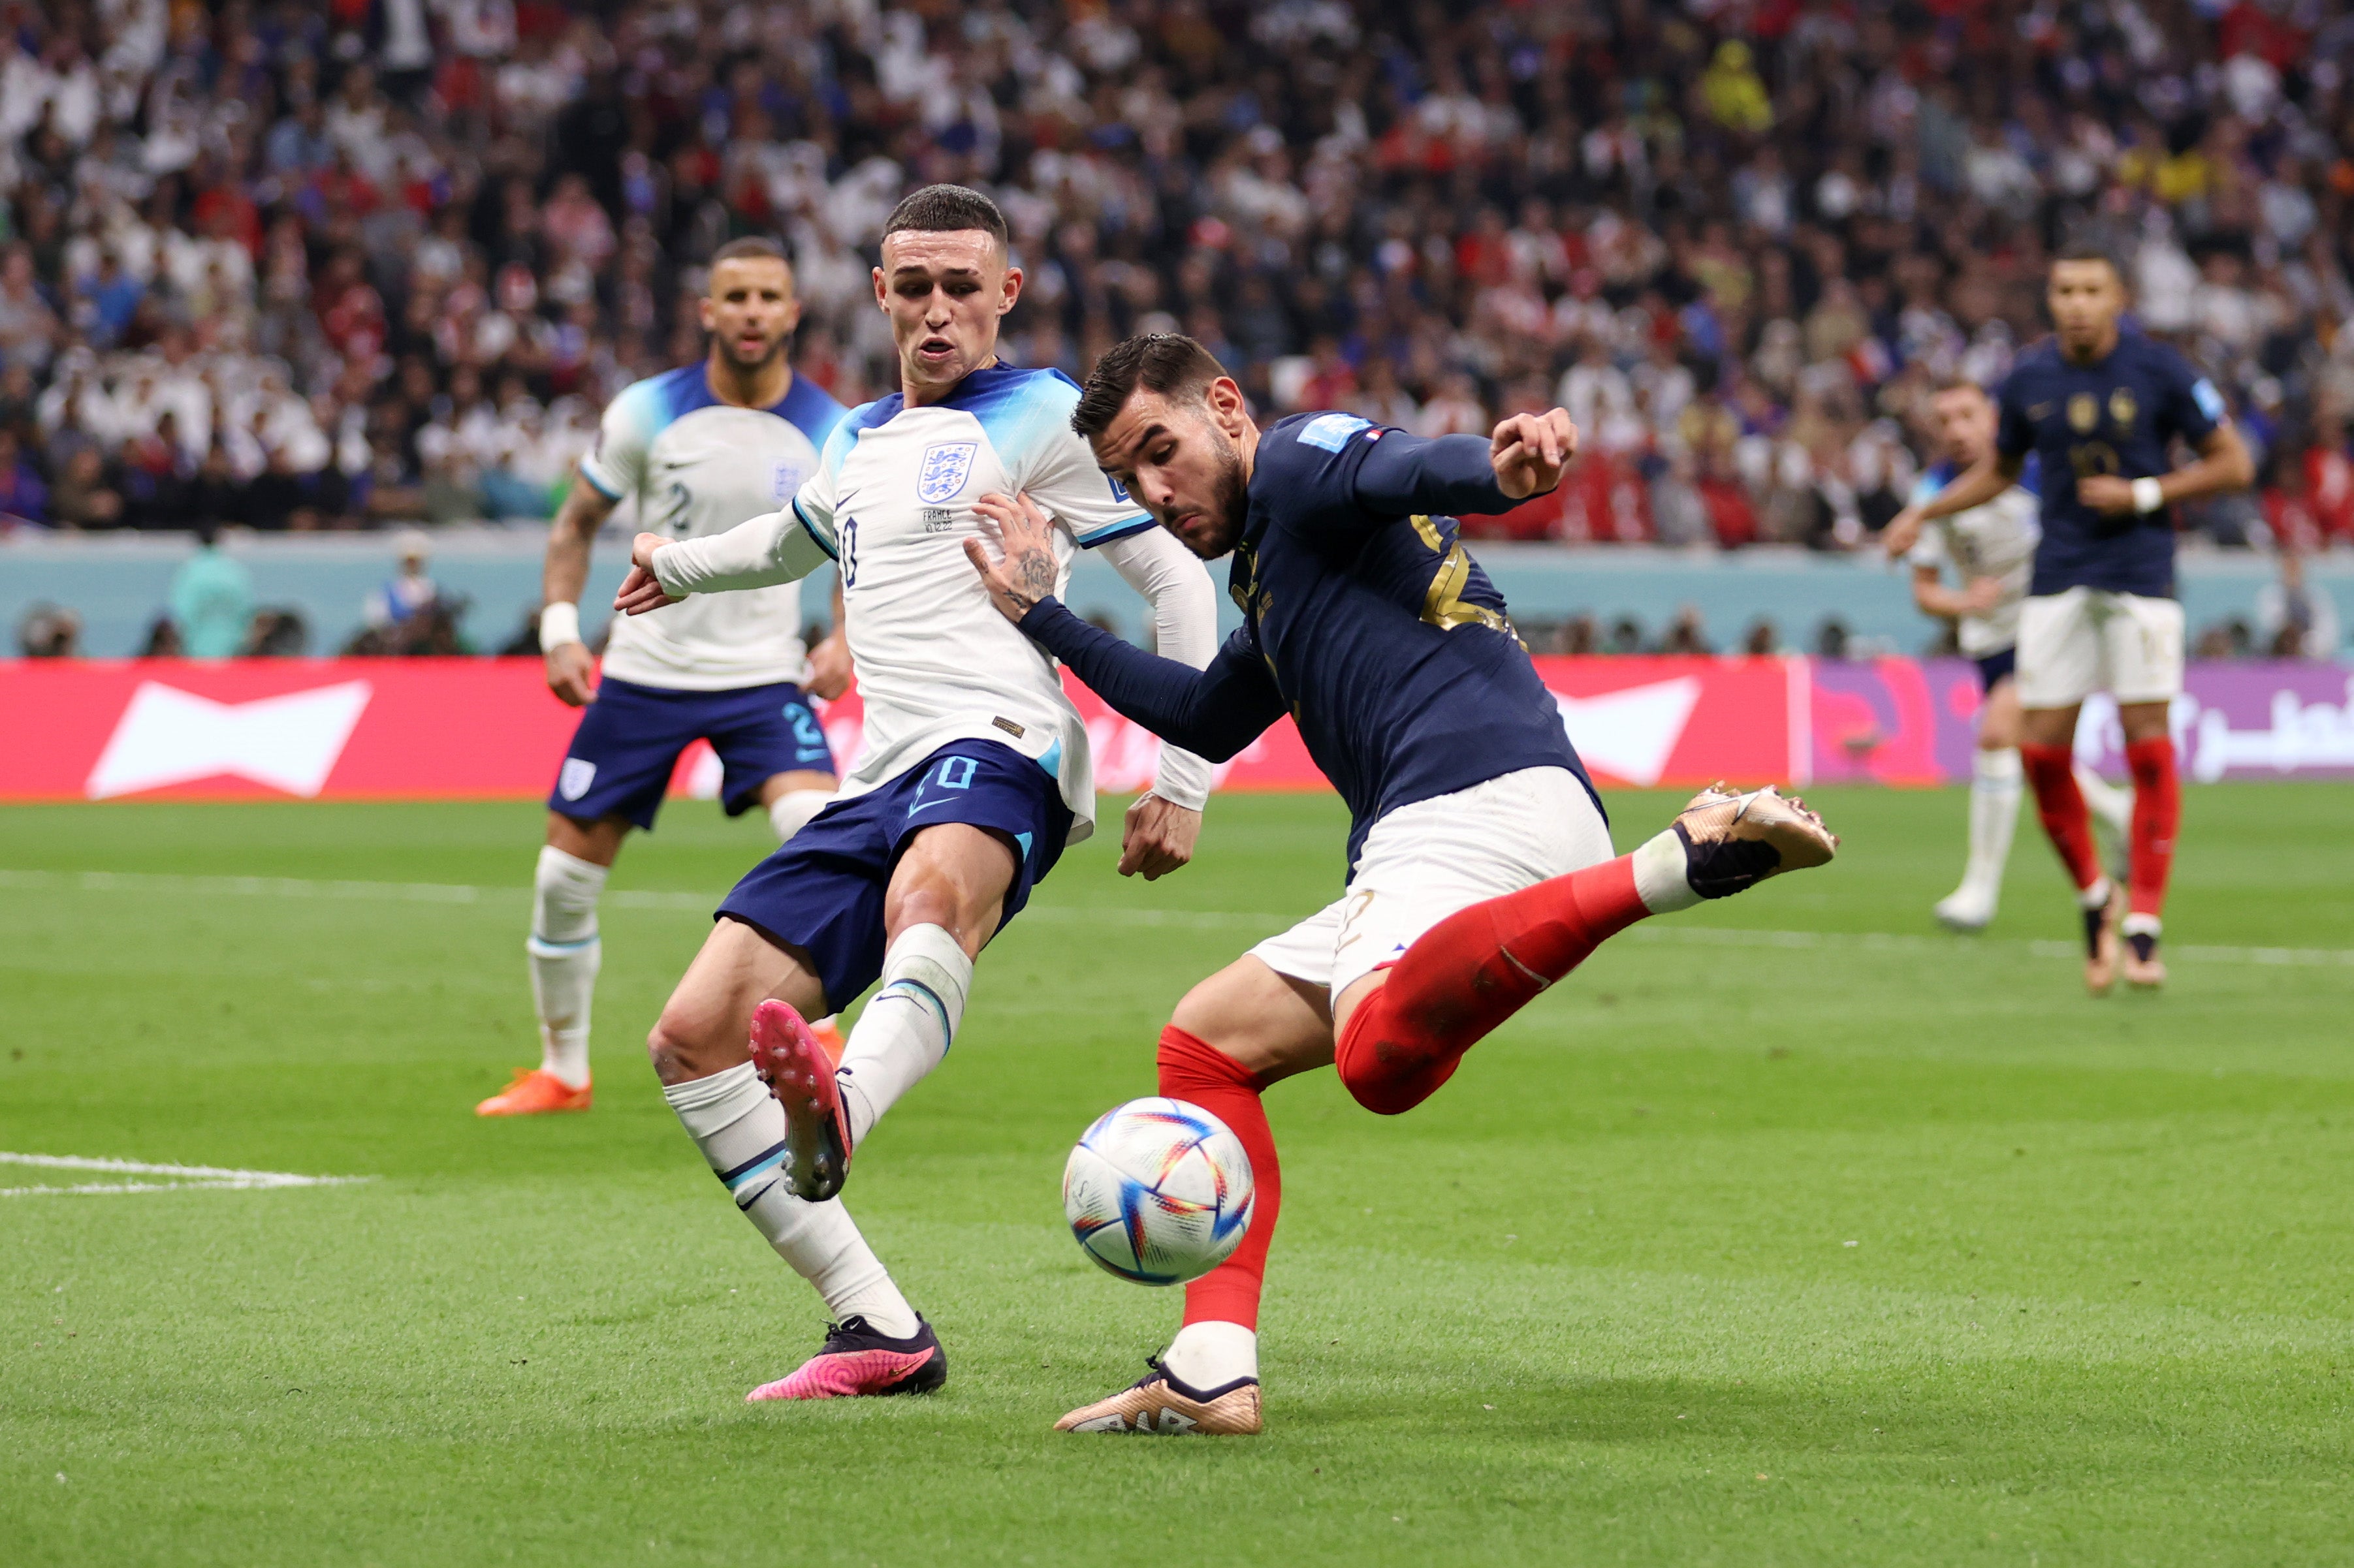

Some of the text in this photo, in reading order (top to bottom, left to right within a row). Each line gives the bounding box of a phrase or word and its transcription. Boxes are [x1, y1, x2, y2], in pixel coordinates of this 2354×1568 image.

[661, 482, 692, 533] 2
[923, 509, 951, 522] FRANCE
[834, 516, 858, 588] 0
[782, 702, 822, 745] 2
